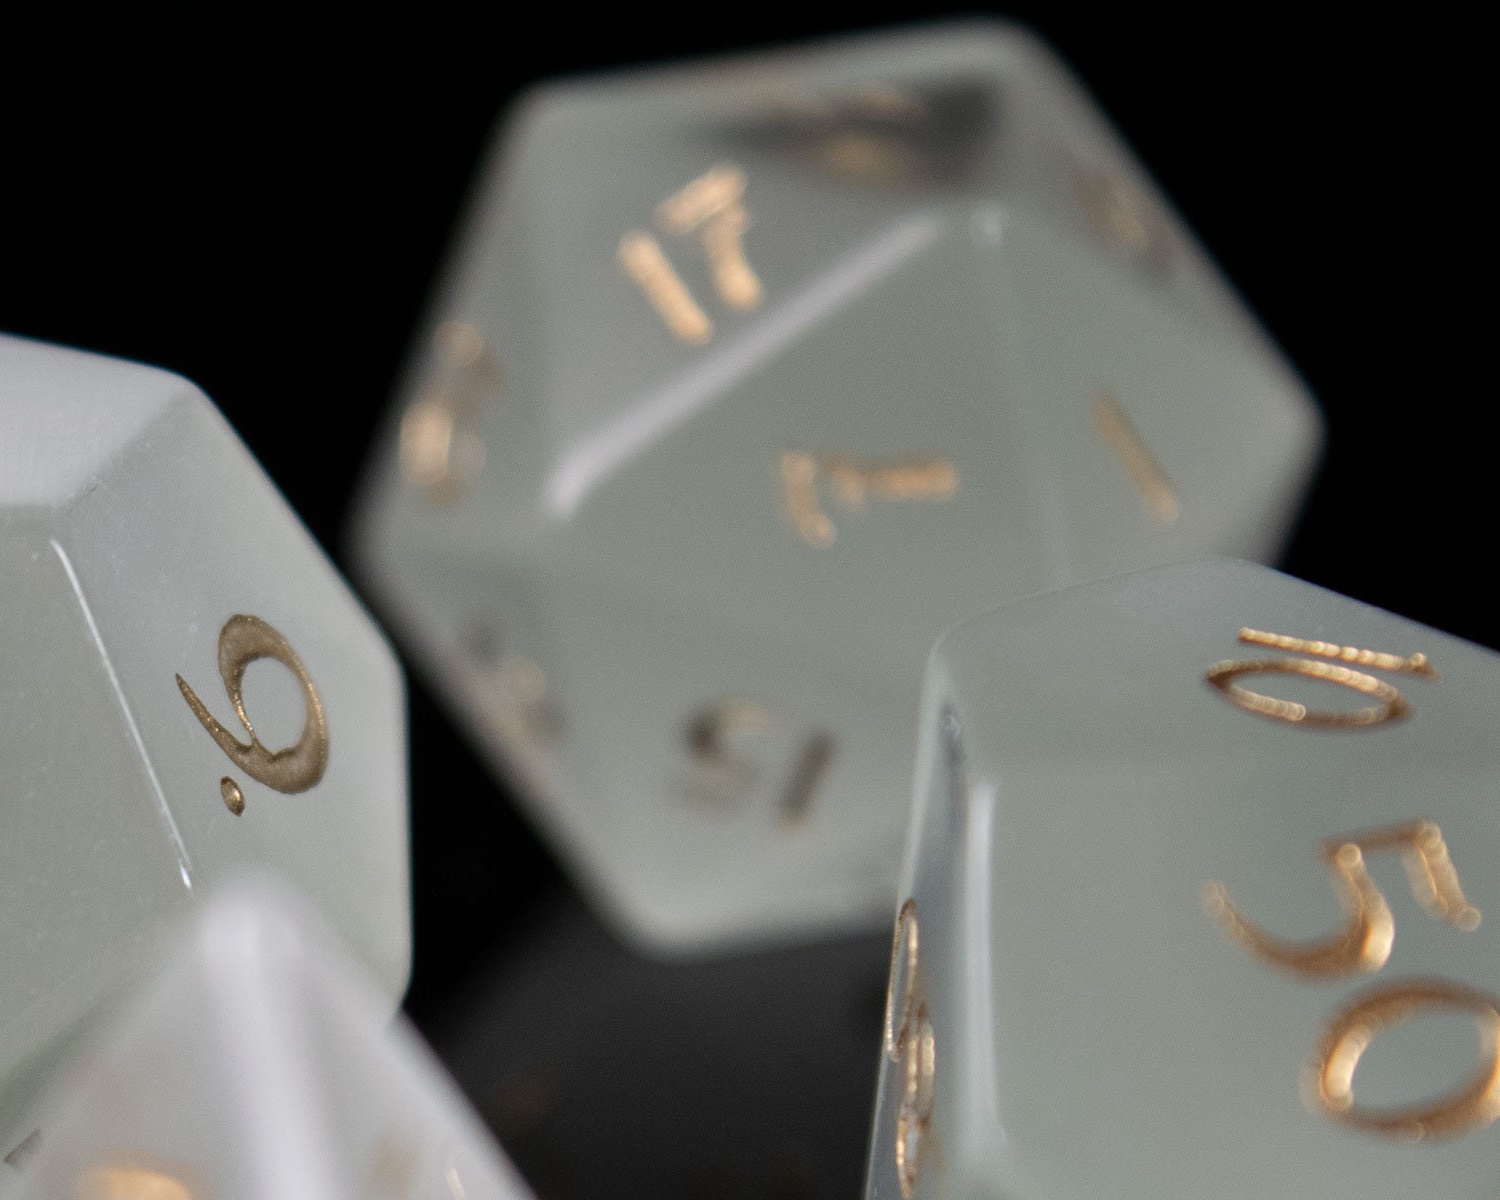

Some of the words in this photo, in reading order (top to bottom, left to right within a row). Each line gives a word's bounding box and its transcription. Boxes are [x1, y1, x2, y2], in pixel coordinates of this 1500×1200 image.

[618, 162, 762, 346] 17
[1203, 625, 1444, 735] 10
[1203, 818, 1500, 1148] 50
